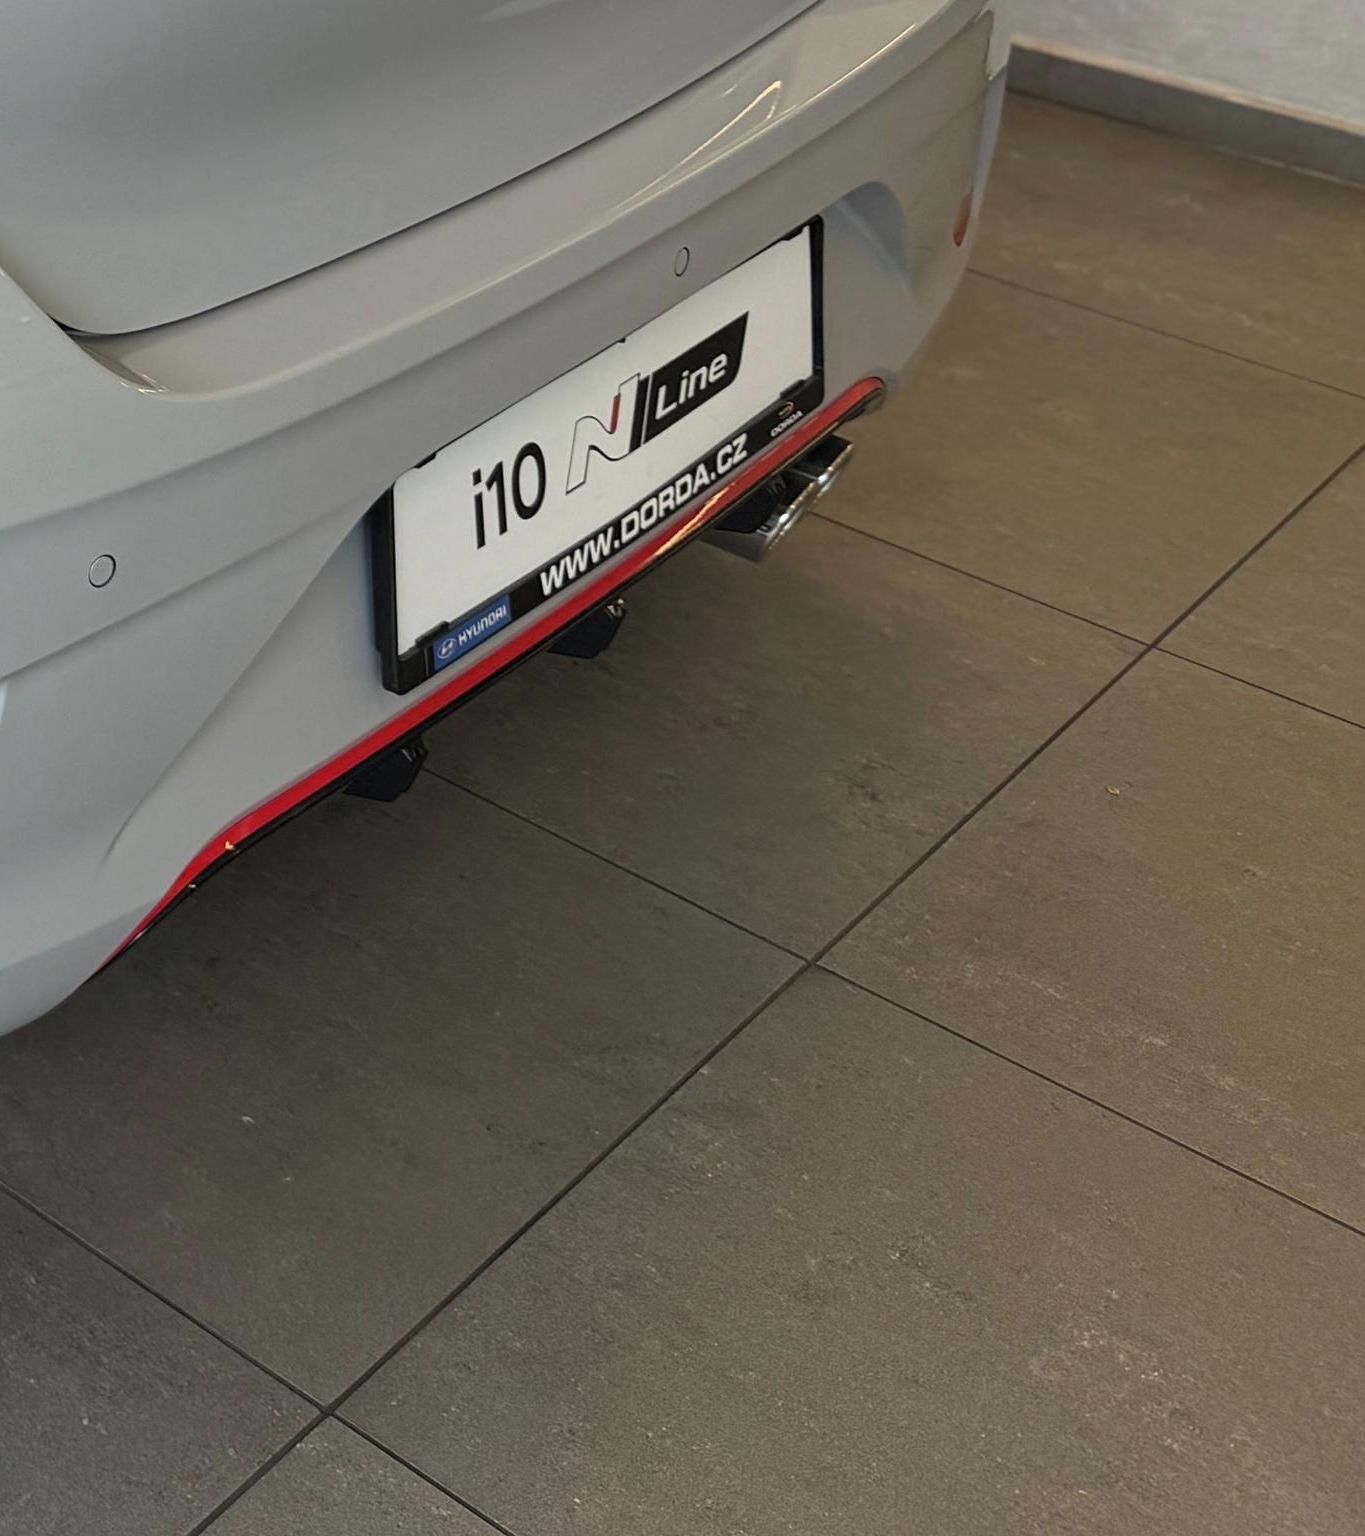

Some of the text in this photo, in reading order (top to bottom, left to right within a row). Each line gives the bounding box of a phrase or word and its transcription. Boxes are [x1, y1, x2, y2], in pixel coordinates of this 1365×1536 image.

[472, 442, 547, 550] i10
[655, 353, 728, 422] Line
[540, 432, 749, 596] WWW.DORDA.CZ
[458, 604, 508, 647] HYUNDAI
